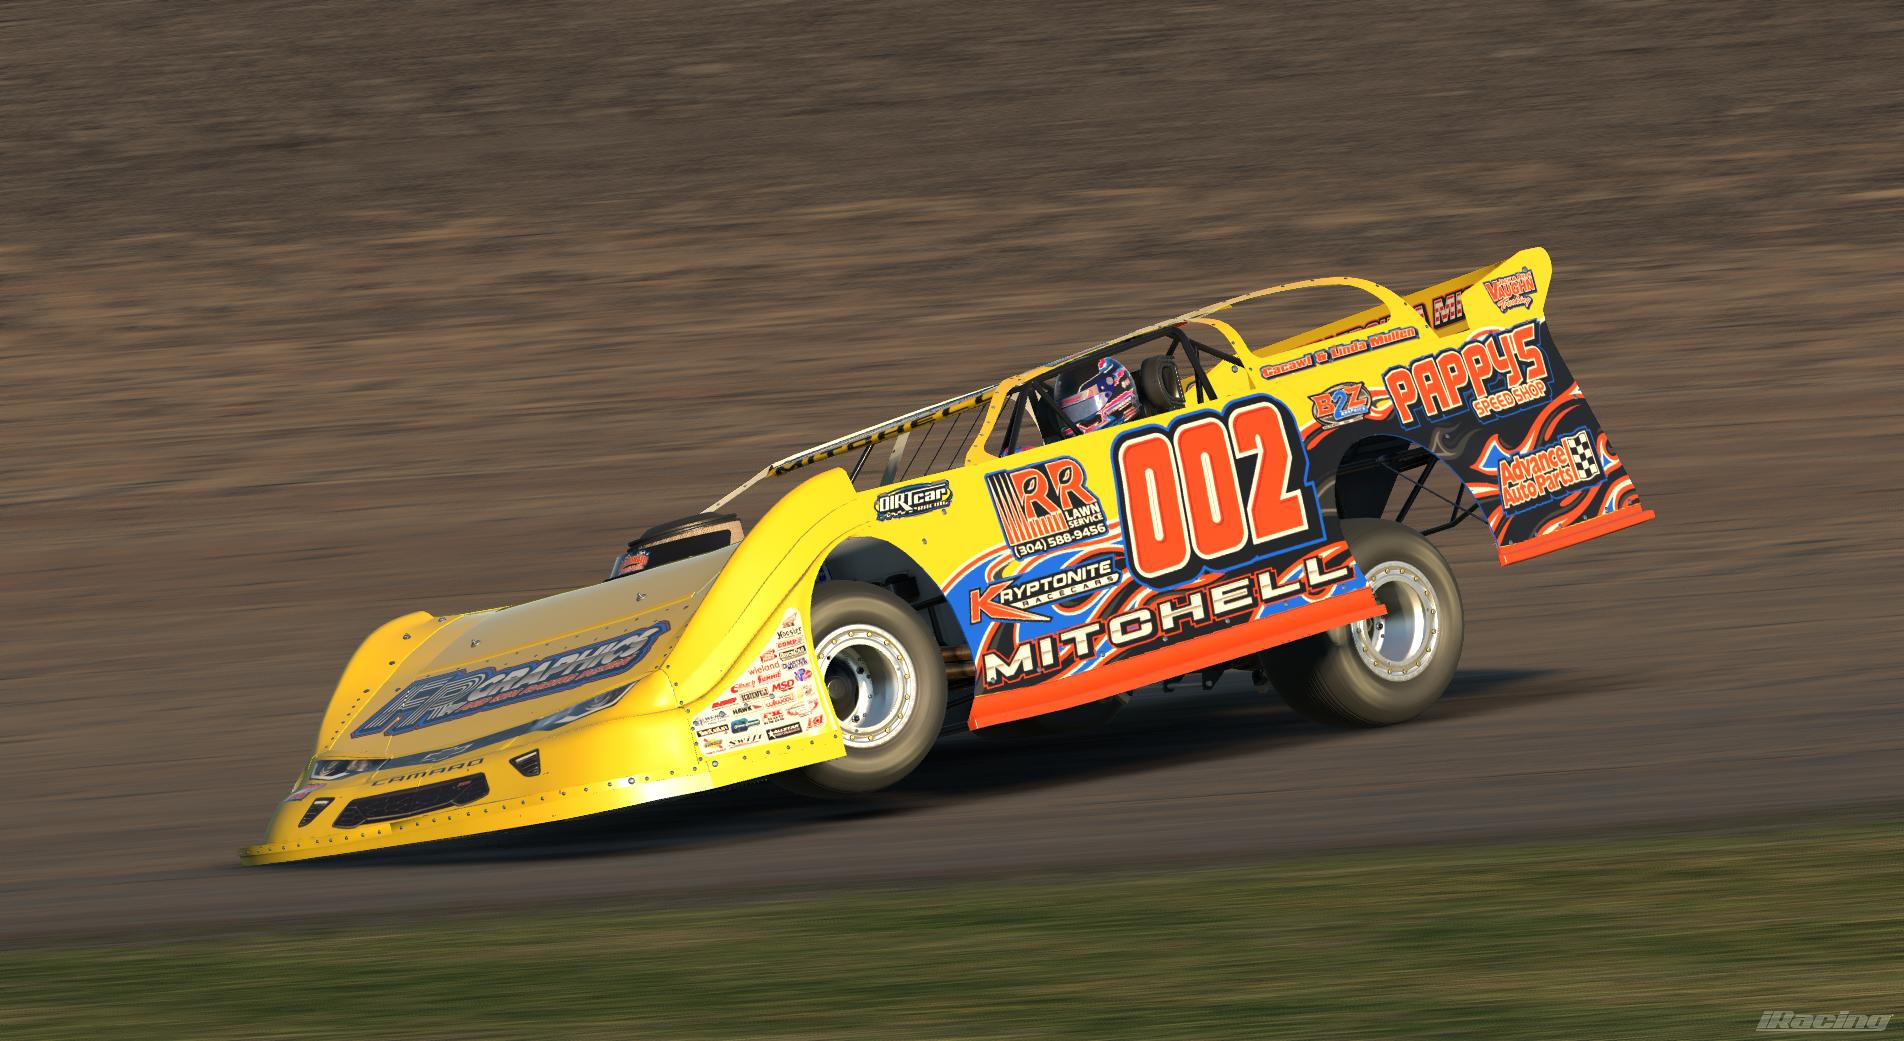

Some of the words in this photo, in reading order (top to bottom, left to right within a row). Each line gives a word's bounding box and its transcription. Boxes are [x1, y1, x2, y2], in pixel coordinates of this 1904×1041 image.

[1486, 279, 1535, 302] VAUGHN
[1315, 350, 1328, 363] &
[1330, 340, 1368, 359] Linda
[1370, 327, 1416, 348] Mullen
[1311, 383, 1367, 420] B2Z
[1473, 390, 1515, 418] SPEED
[1512, 380, 1546, 404] SHOP
[1500, 445, 1568, 488] Advance
[879, 488, 947, 512] DIRTcar
[1117, 400, 1309, 580] 002
[1502, 480, 1538, 509] Auto
[1534, 466, 1576, 496] Parts
[1065, 502, 1100, 520] LAWN
[1068, 512, 1104, 528] SERVICE
[1014, 540, 1047, 558] (304)
[1048, 523, 1106, 547] 588-9456
[970, 559, 1112, 624] KRYPTONITE
[1022, 575, 1115, 608] RACECARS
[984, 556, 1353, 683] MITCHELL
[748, 661, 780, 676] wieland
[771, 679, 795, 692] MSD
[732, 705, 752, 715] HAWK
[371, 757, 484, 787] CAMARO
